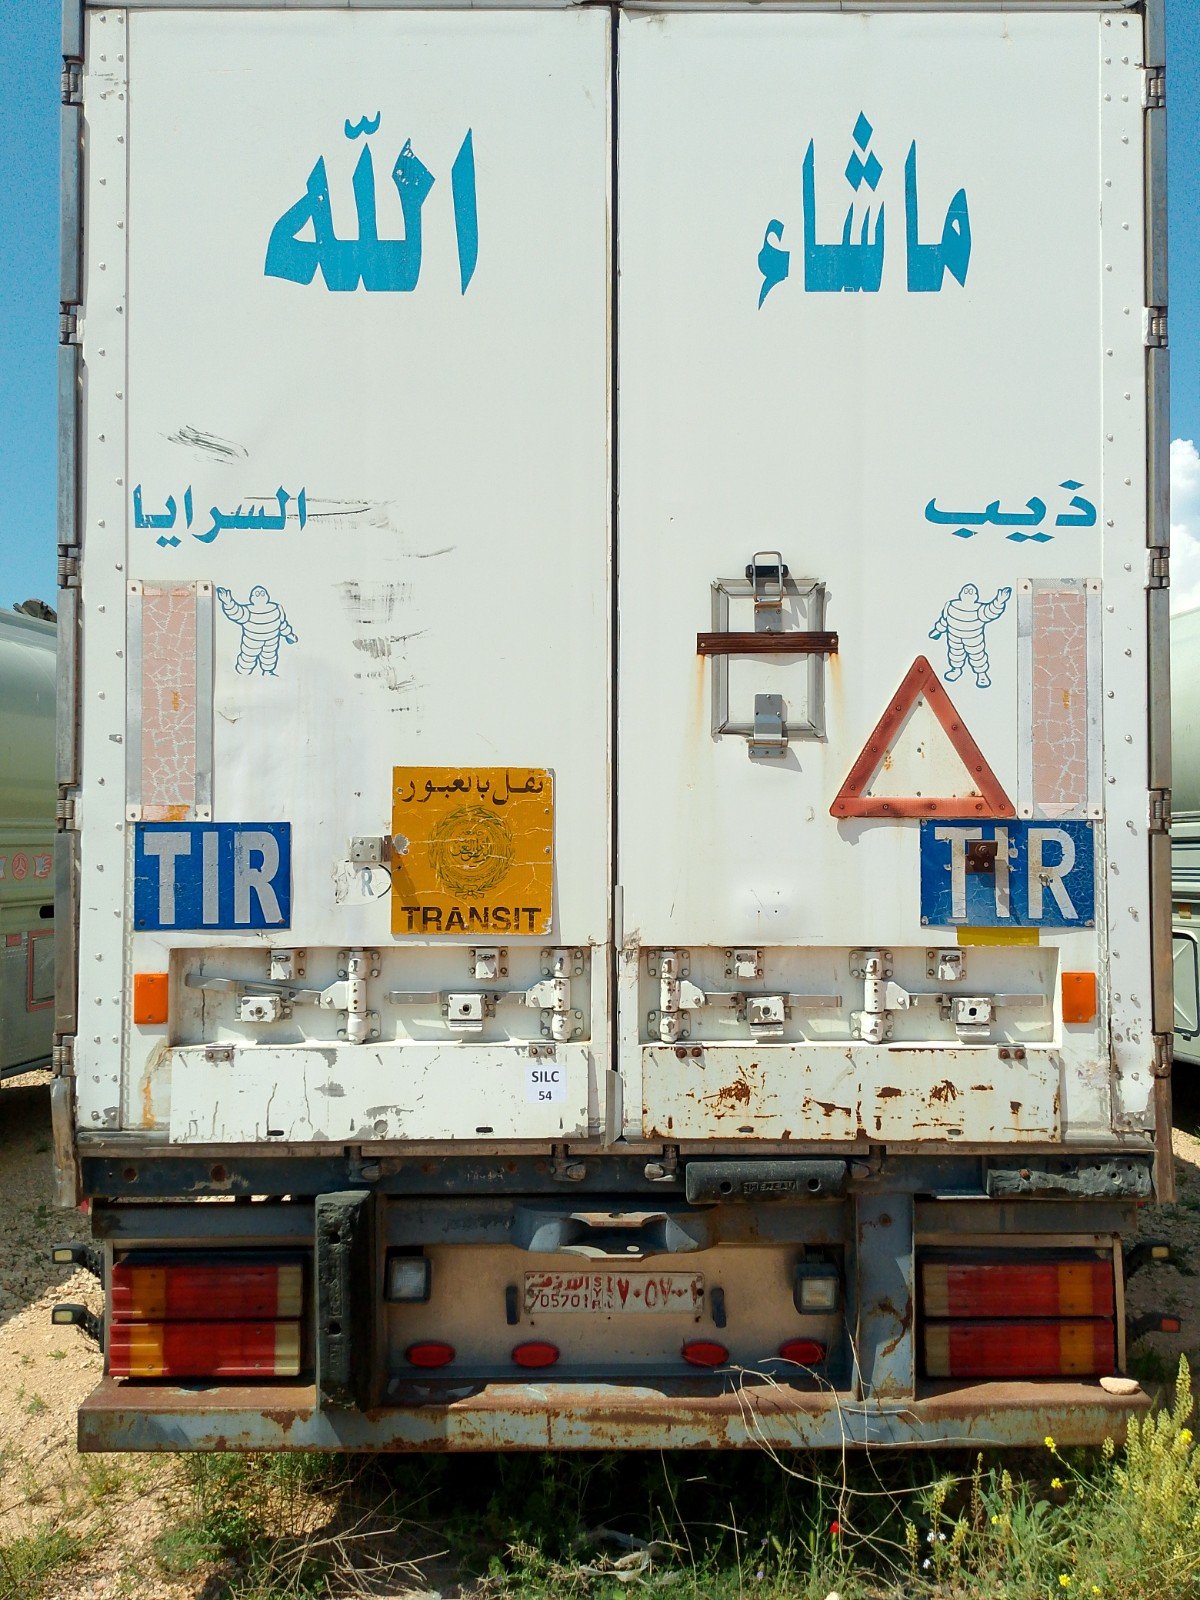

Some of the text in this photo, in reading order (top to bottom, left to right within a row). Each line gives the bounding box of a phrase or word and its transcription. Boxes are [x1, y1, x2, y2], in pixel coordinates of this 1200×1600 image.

[264, 111, 972, 310] ماشاء الله
[133, 479, 1097, 548] ذيب السرايا
[143, 831, 284, 925] TIR
[934, 826, 1079, 919] TIR
[400, 906, 542, 932] TRANSIT
[531, 1070, 560, 1083] SILC
[538, 1090, 553, 1101] 54
